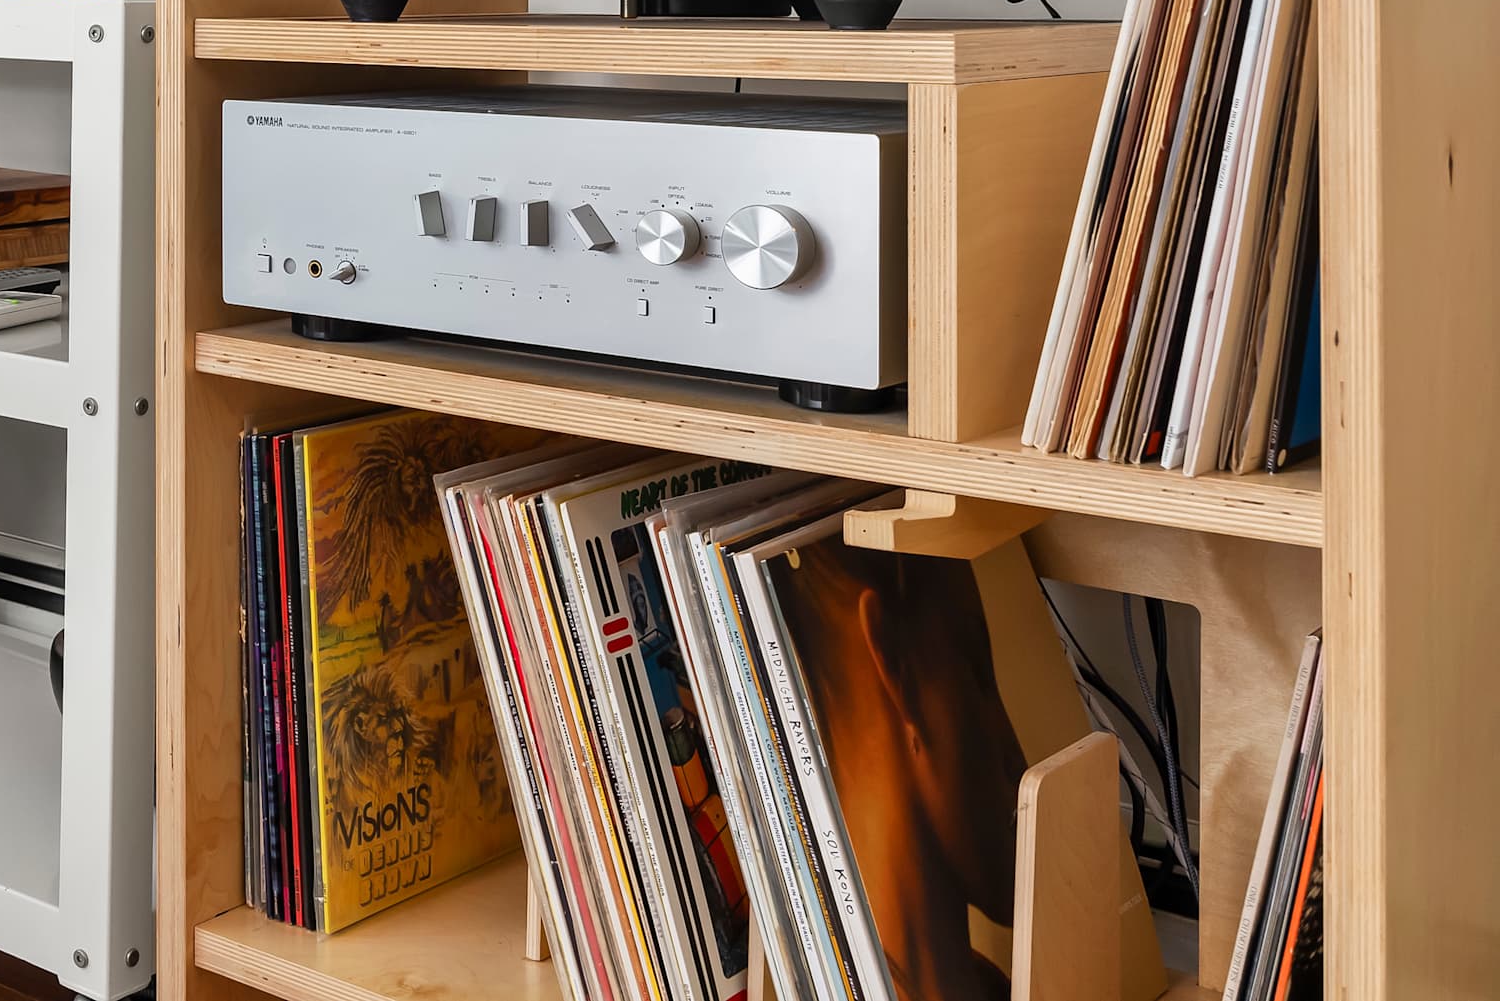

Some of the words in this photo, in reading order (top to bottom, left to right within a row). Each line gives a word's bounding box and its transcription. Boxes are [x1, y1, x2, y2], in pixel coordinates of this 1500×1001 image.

[254, 115, 284, 127] YAMAHA
[620, 478, 667, 520] HEART
[671, 473, 689, 497] OF
[690, 465, 718, 493] THE
[564, 600, 579, 639] Roots
[575, 642, 592, 686] Radics
[767, 640, 797, 713] MIDNIGHT
[735, 691, 753, 737] GREENSLEEVES
[748, 737, 763, 770] PRESENTS
[756, 770, 771, 801] CHANNEL
[765, 801, 775, 816] ONE
[769, 816, 788, 864] SOUNDSYSTEM
[783, 865, 795, 887] DOWN
[789, 886, 797, 896] IN
[792, 895, 801, 910] THE
[796, 909, 806, 925] DUB
